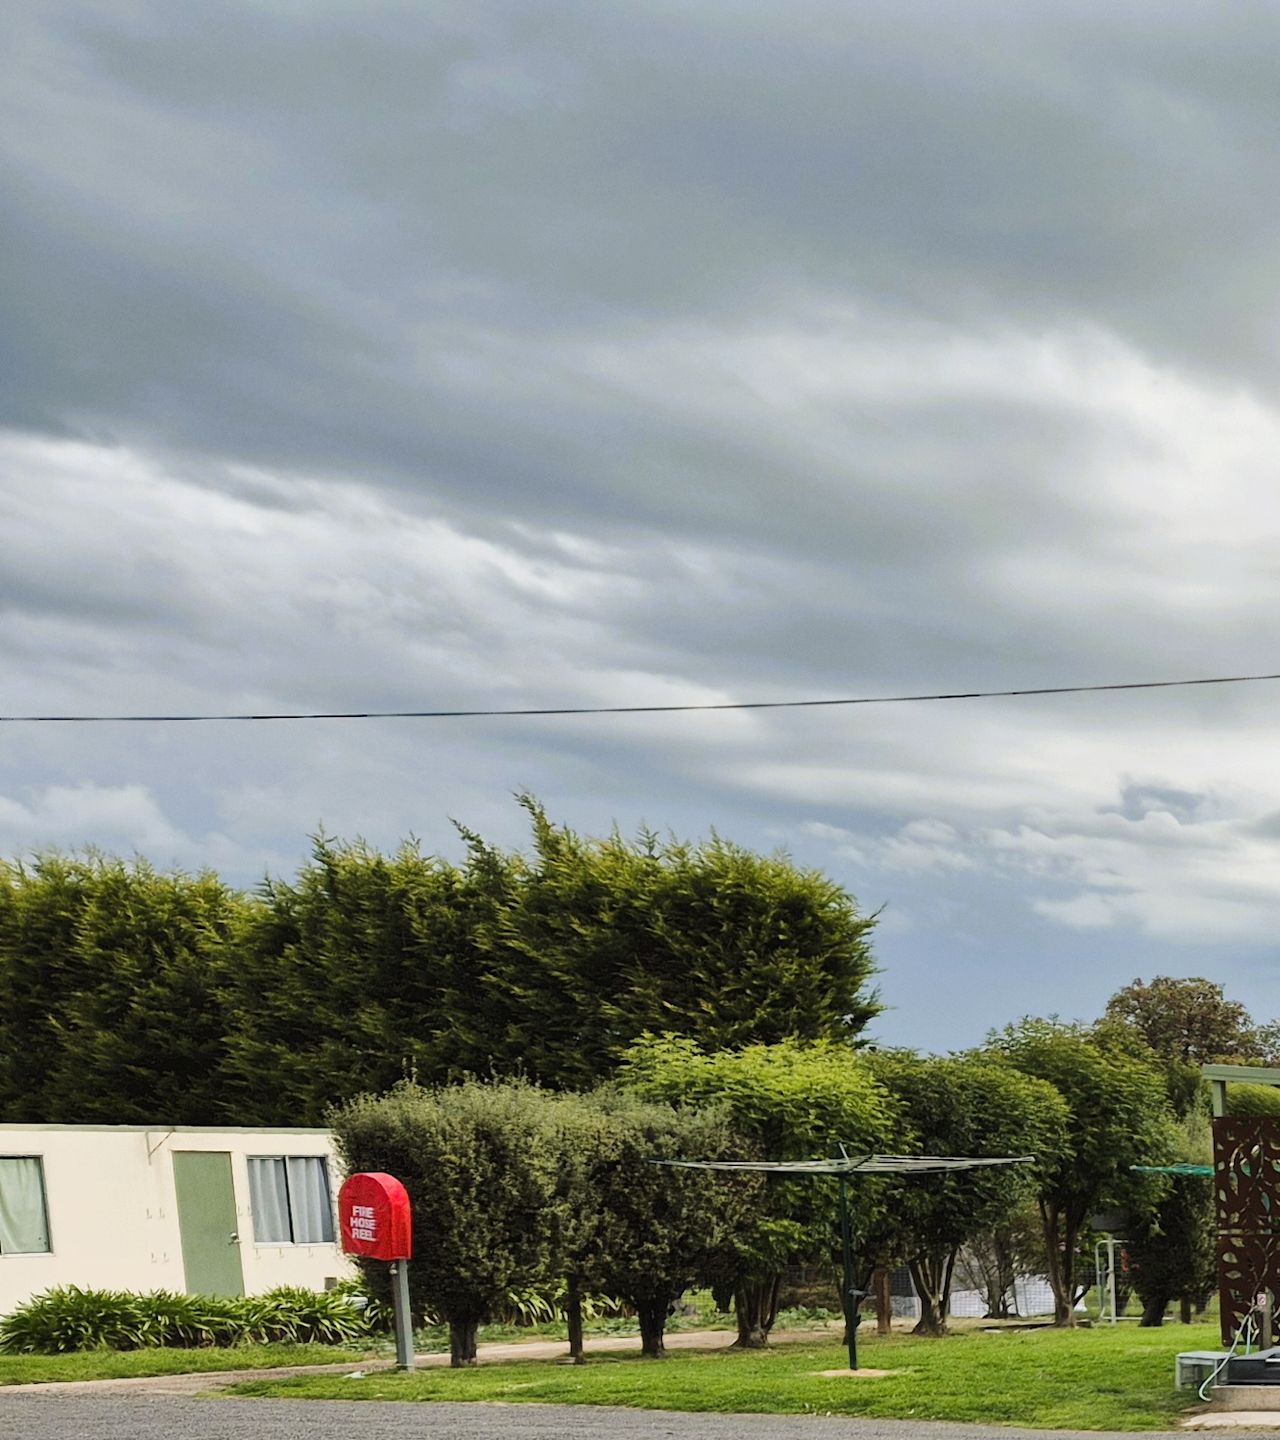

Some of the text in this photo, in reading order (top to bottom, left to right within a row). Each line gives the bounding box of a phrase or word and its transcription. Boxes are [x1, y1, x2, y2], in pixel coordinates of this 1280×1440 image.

[352, 1205, 375, 1219] FIRE
[350, 1216, 377, 1230] HOSE
[351, 1228, 377, 1242] REEL
